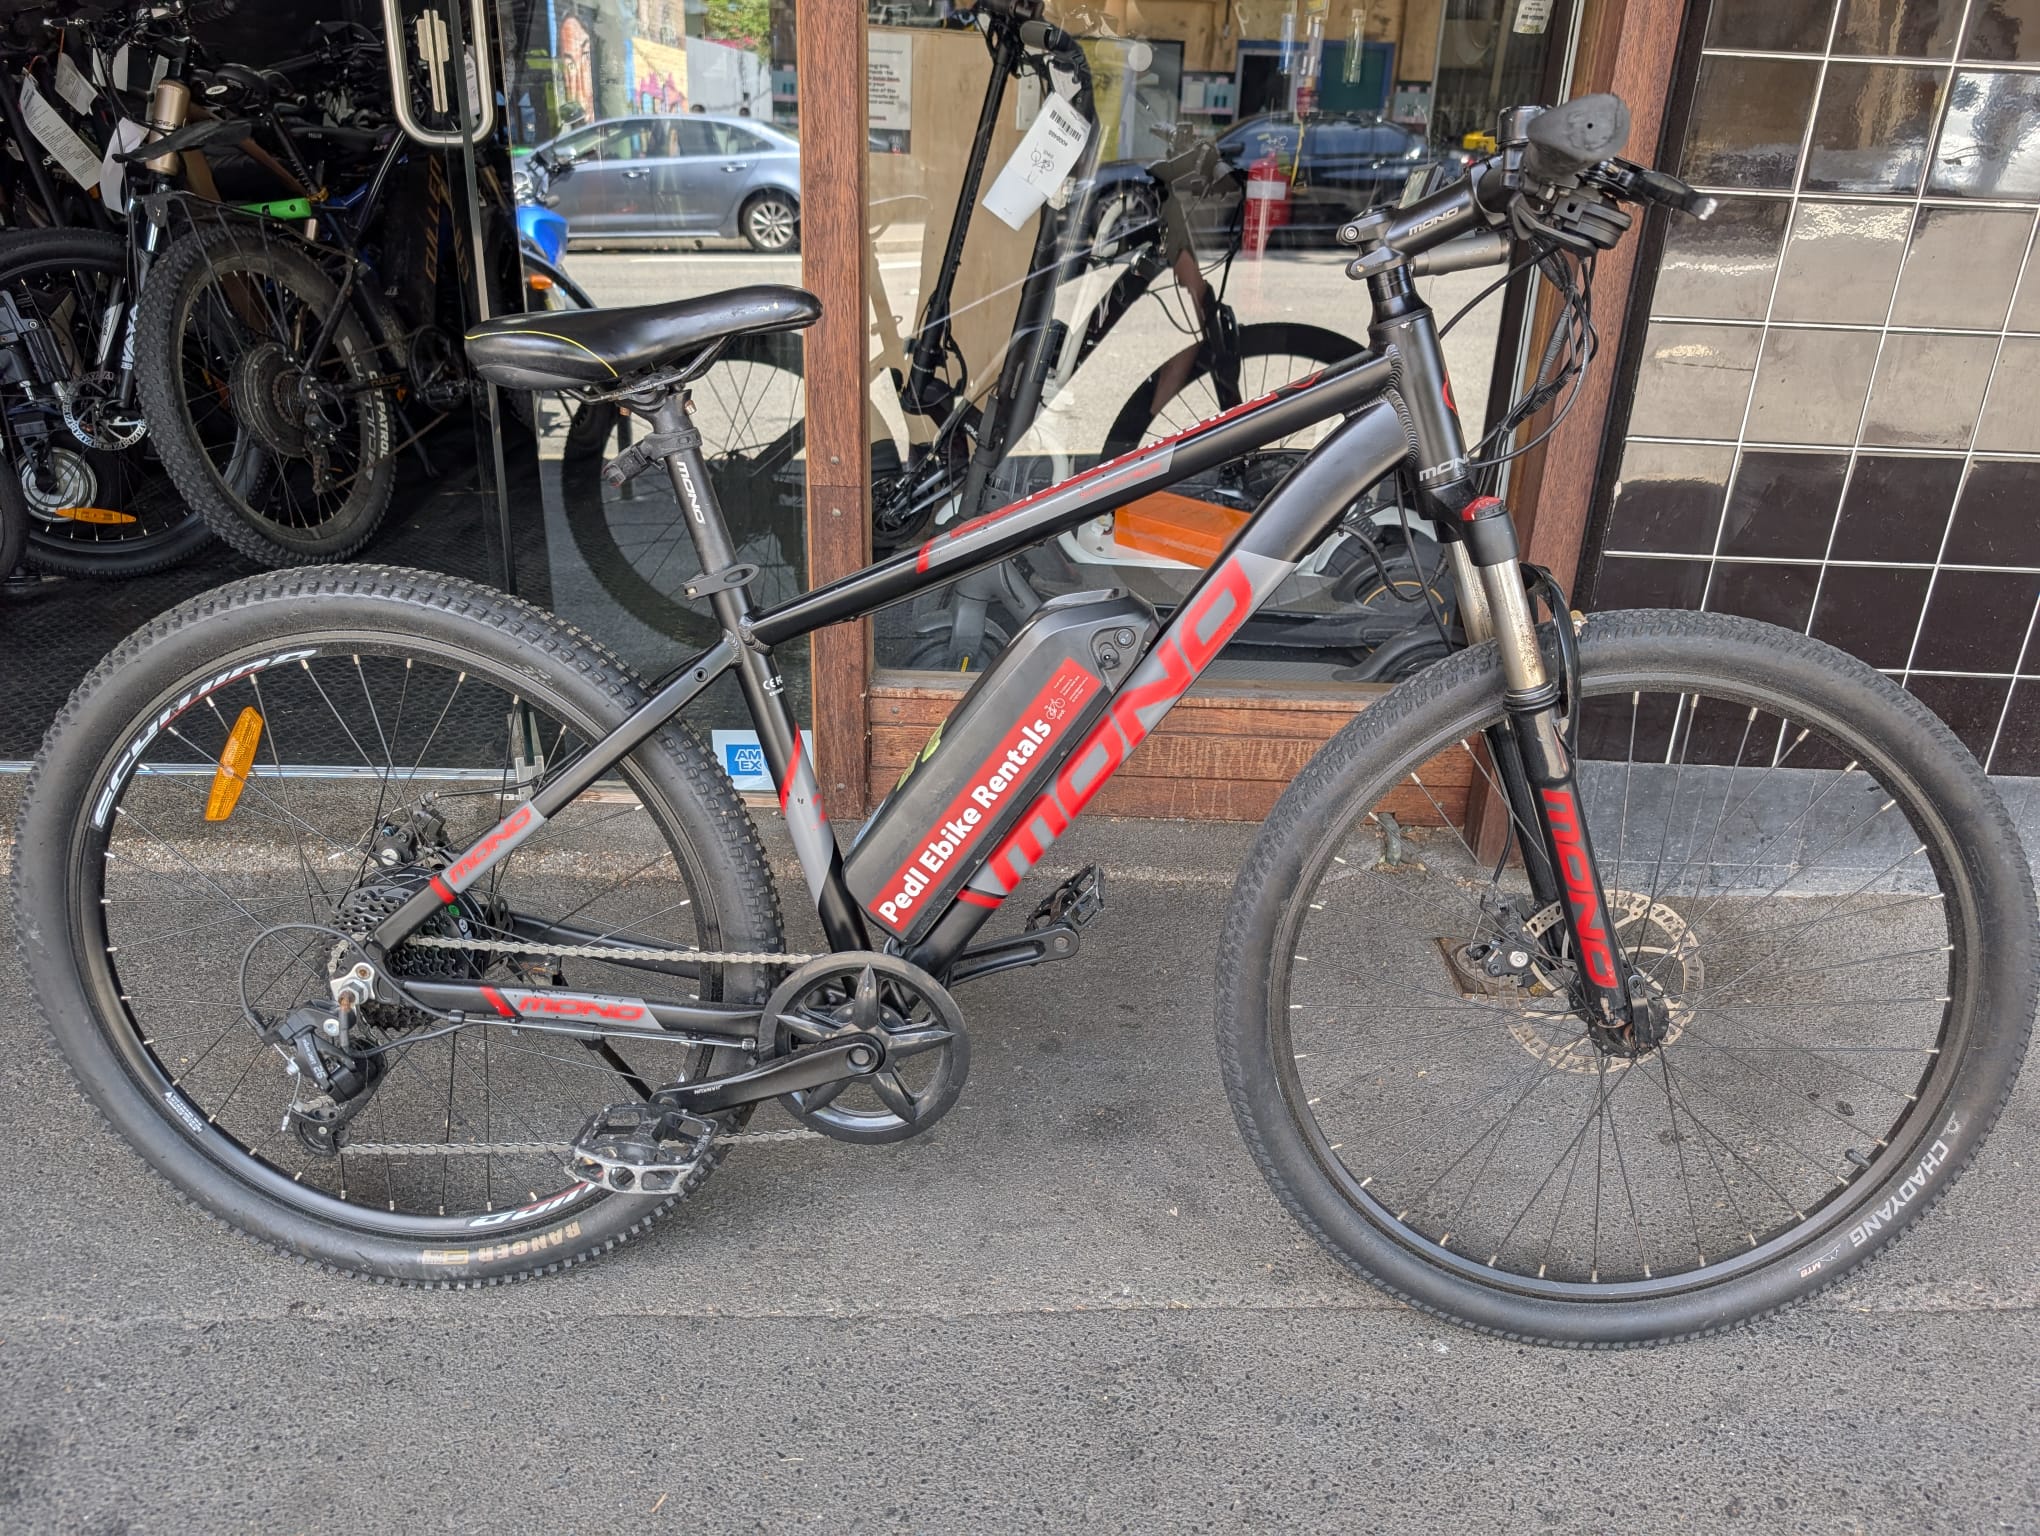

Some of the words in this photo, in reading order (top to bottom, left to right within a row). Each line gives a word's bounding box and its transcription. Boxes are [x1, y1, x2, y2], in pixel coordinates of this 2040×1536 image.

[1408, 206, 1459, 236] MONO
[676, 461, 706, 525] MONO
[987, 557, 1254, 894] MONO
[448, 807, 532, 884] MONO
[878, 866, 930, 923] Pedl
[918, 807, 982, 873] Ebike
[970, 718, 1051, 809] Rentals
[1541, 788, 1619, 989] MONO
[519, 996, 646, 1021] MONO
[1849, 1139, 1950, 1248] CHAOYANG
[477, 1220, 584, 1262] RANGER
[1800, 1261, 1822, 1278] MTB
